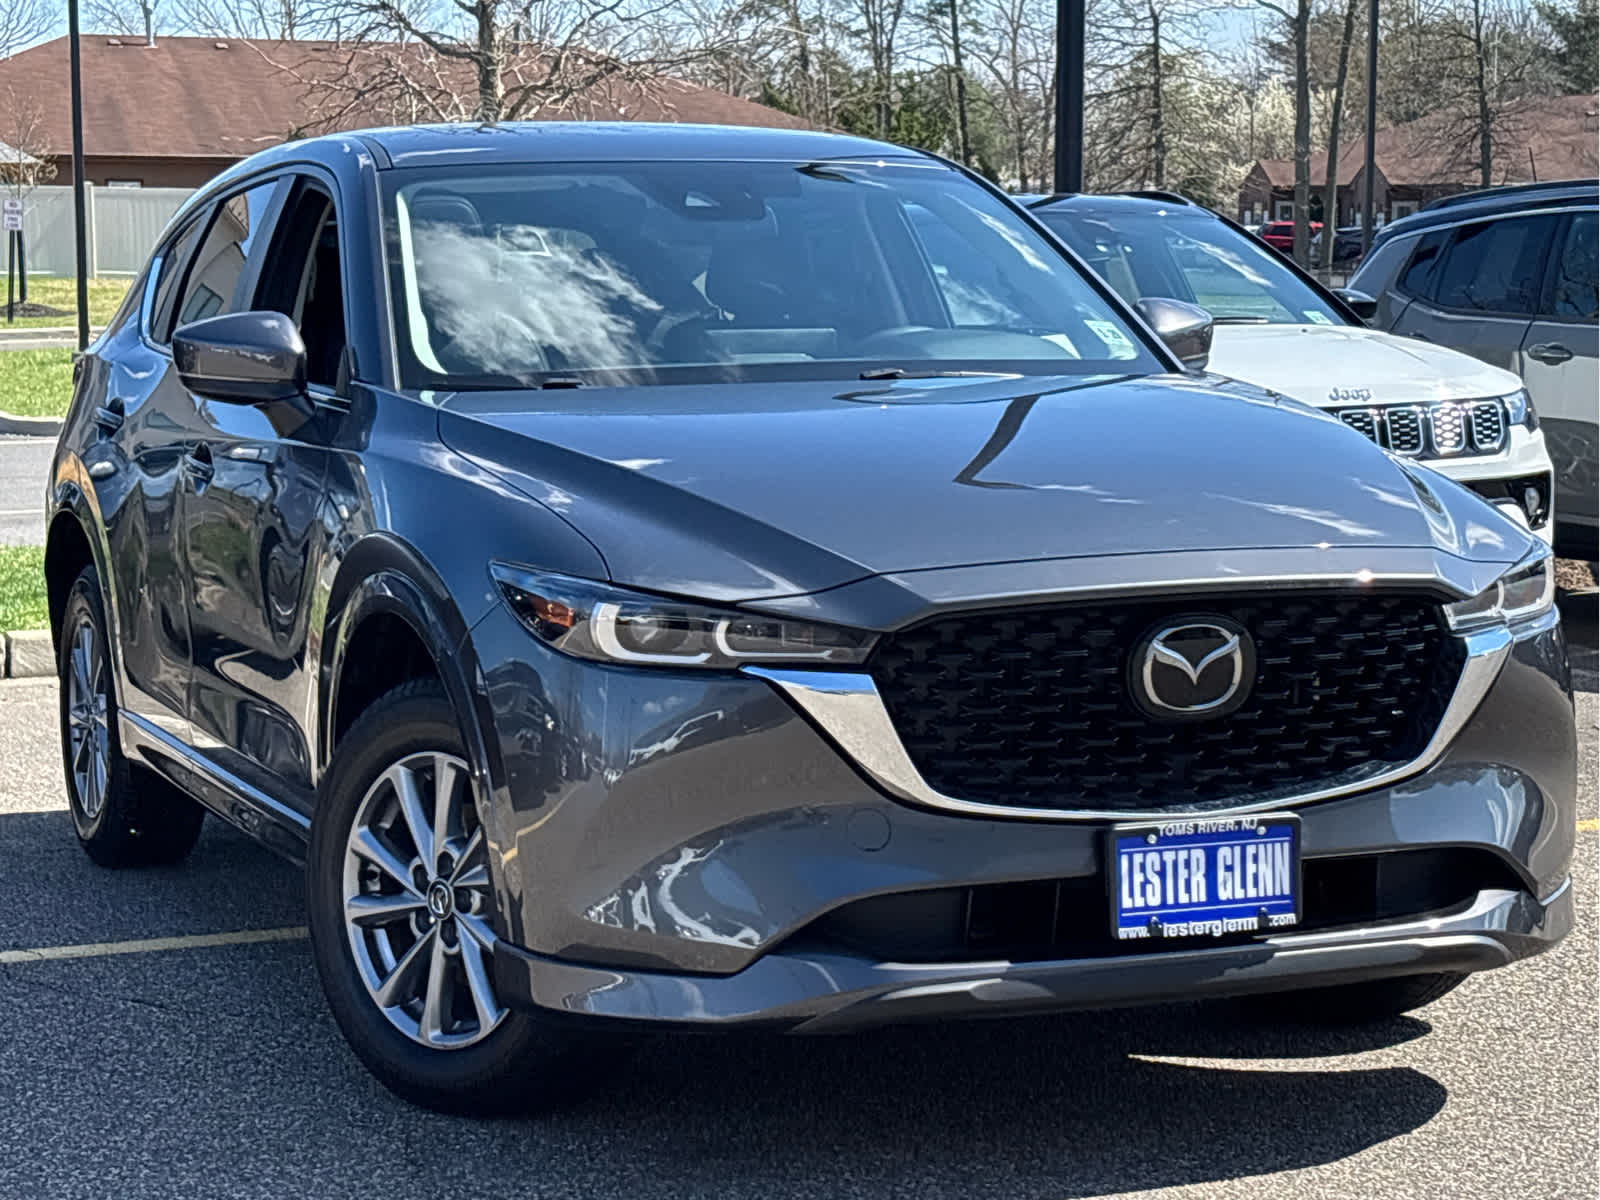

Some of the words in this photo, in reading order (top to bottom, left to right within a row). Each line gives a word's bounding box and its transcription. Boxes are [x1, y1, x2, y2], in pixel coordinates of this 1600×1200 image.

[1158, 823, 1195, 836] TOMS
[1241, 817, 1258, 831] NJ
[1121, 848, 1207, 908] LESTER
[1217, 842, 1290, 900] GLENN
